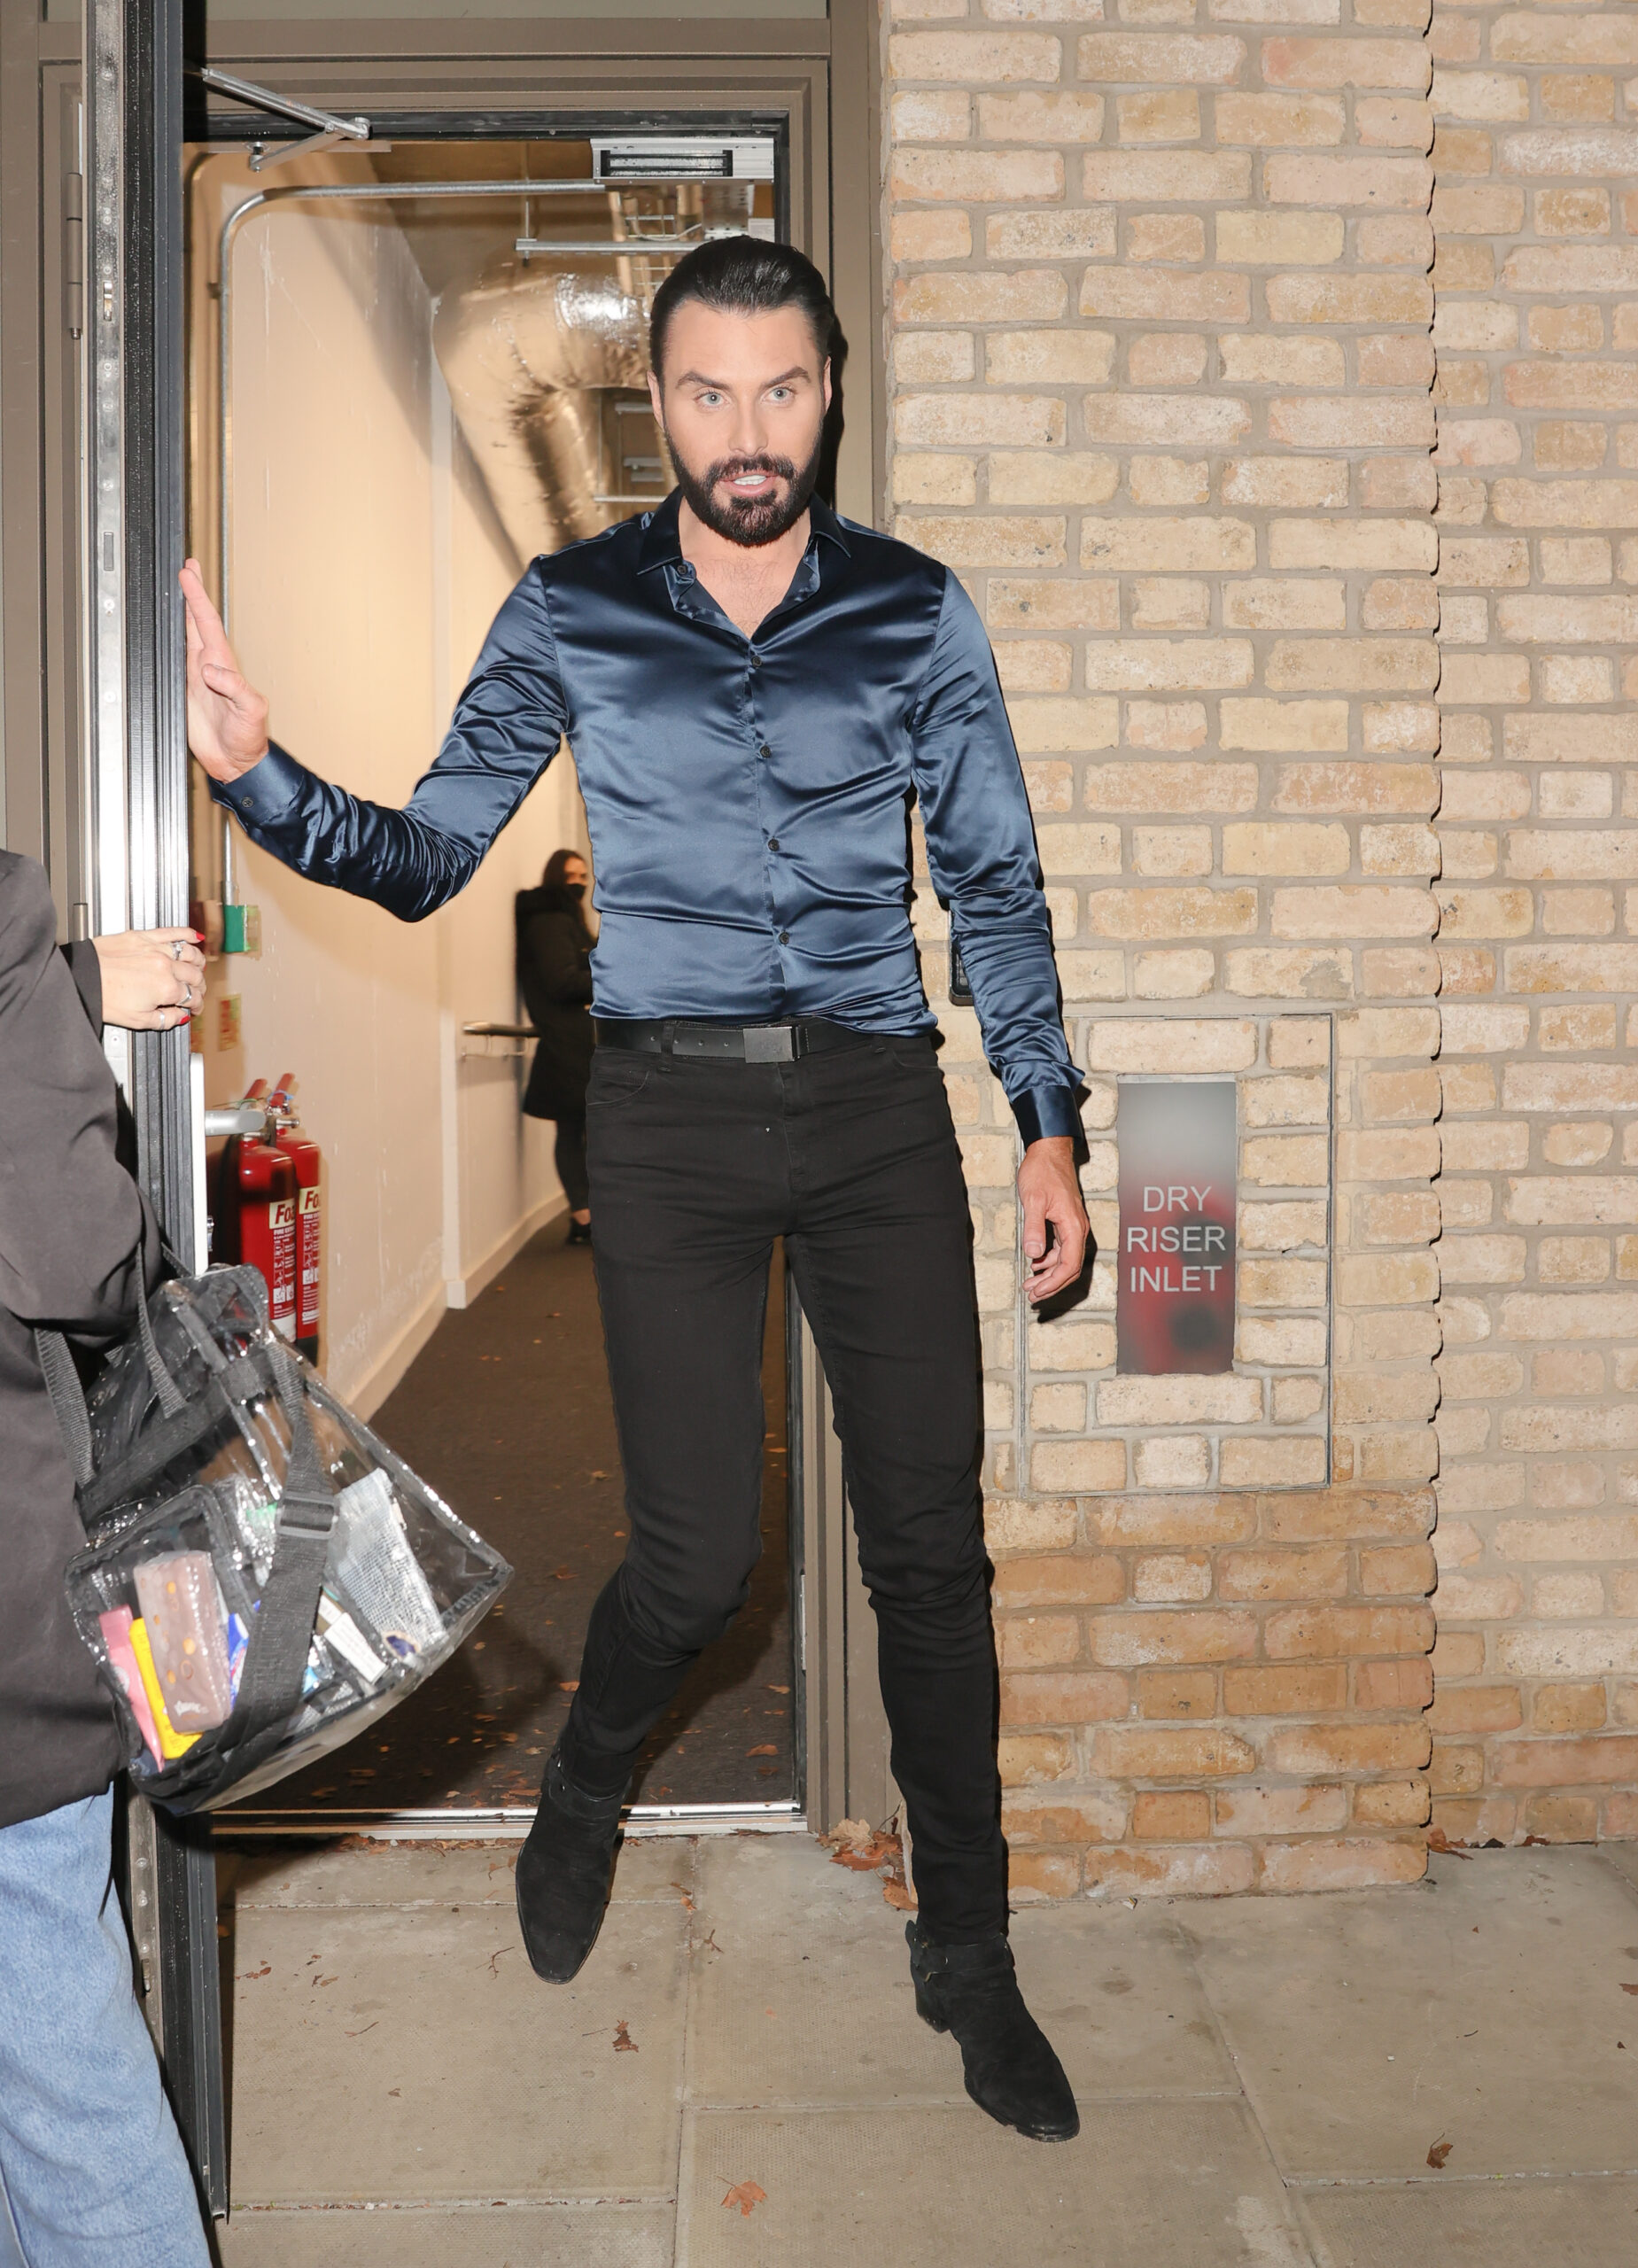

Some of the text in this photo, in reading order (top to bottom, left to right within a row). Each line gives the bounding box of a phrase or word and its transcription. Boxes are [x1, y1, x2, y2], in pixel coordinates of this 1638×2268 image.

[1143, 1185, 1212, 1213] DRY
[1126, 1225, 1226, 1253] RISER
[1130, 1265, 1223, 1293] INLET
